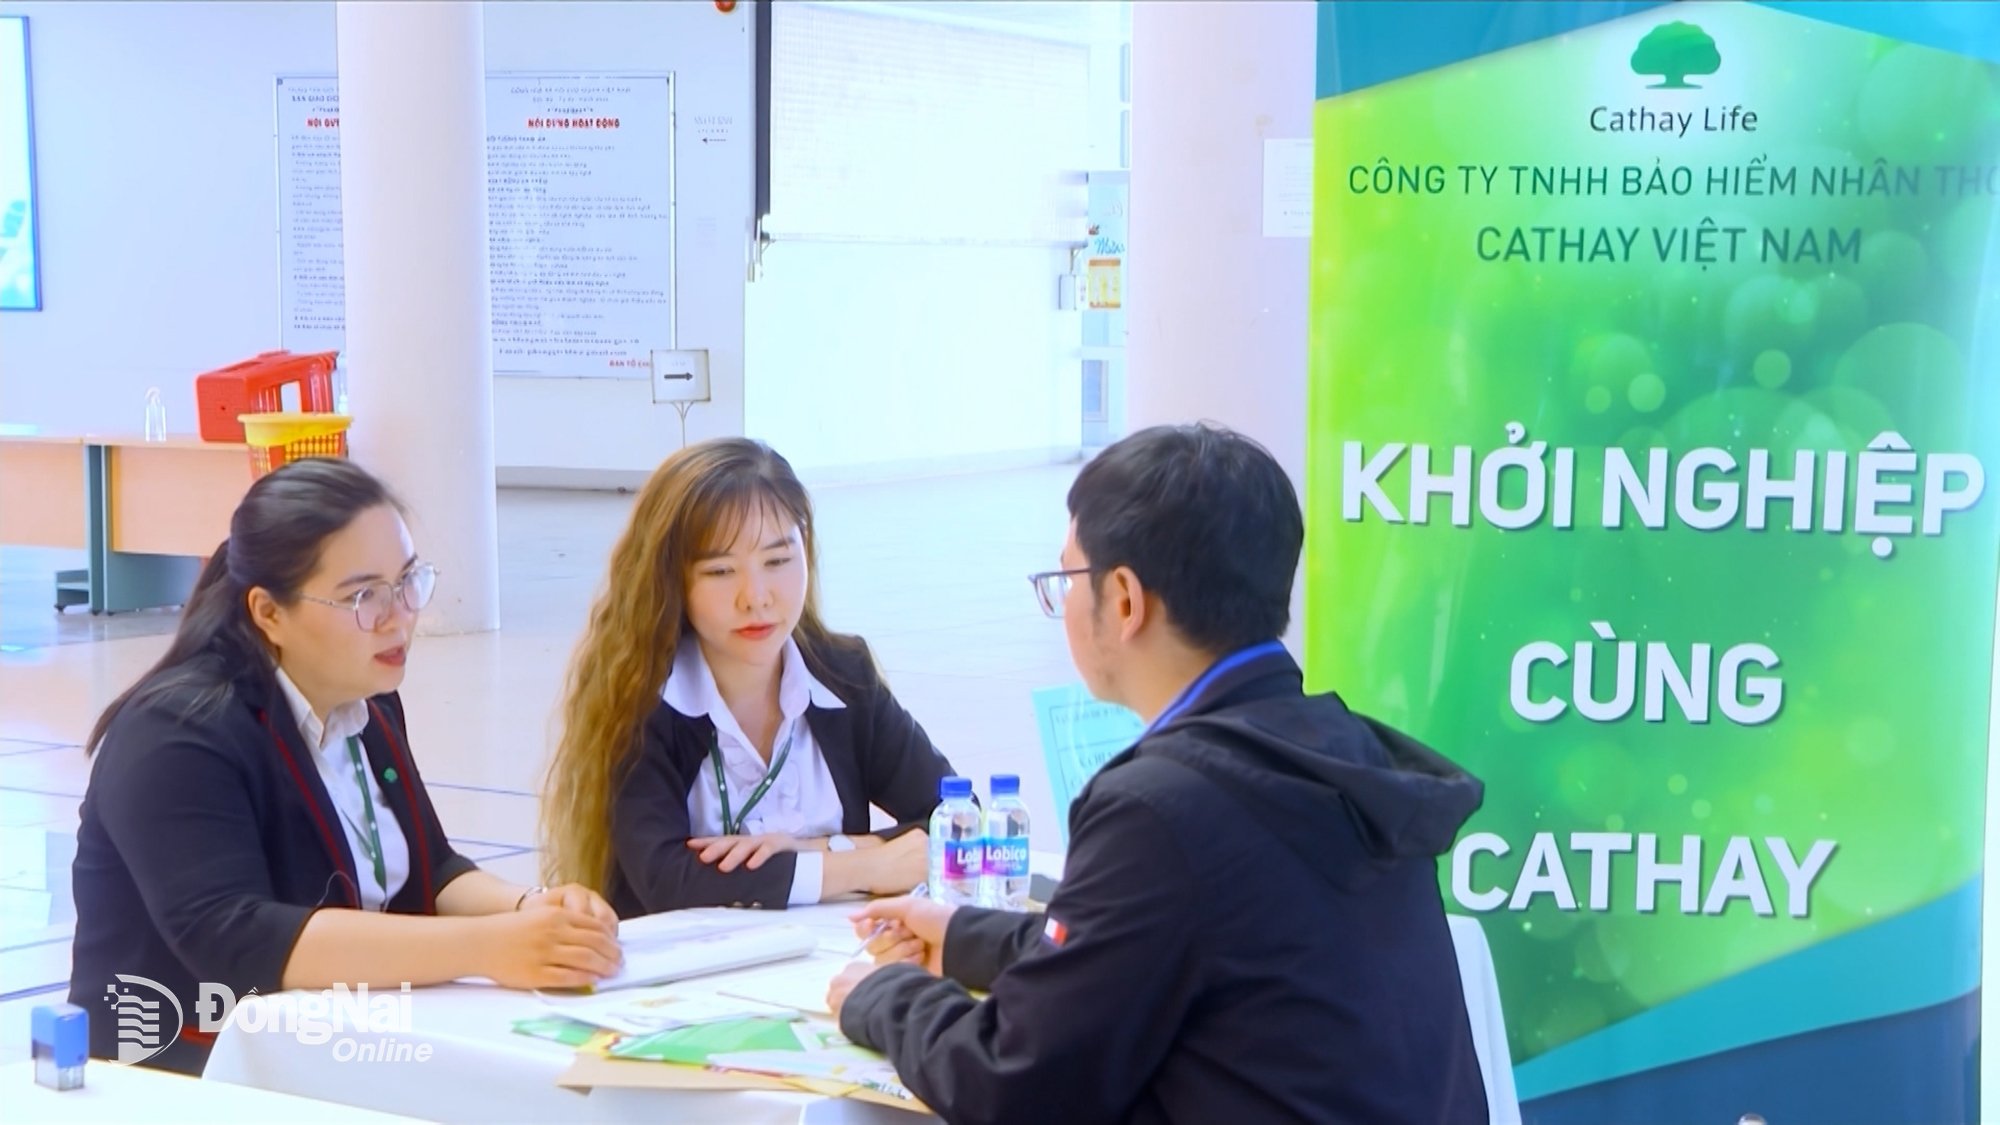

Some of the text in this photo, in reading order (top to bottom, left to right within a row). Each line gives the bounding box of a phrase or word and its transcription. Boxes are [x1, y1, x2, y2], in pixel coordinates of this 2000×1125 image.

[1590, 105, 1758, 139] Cathay Life
[1348, 157, 1446, 195] CÔNG
[1458, 166, 1498, 195] TY
[1509, 166, 1608, 196] TNHH
[1621, 156, 1693, 196] BẢO
[1706, 153, 1798, 197] HIỂM
[1811, 157, 1921, 197] NHÂN
[1476, 216, 1862, 271] CATHAY VIỆT NAM
[1342, 421, 1986, 558] KHỞI NGHIỆP
[1509, 620, 1785, 725] CÙNG
[1450, 831, 1839, 919] CATHAY
